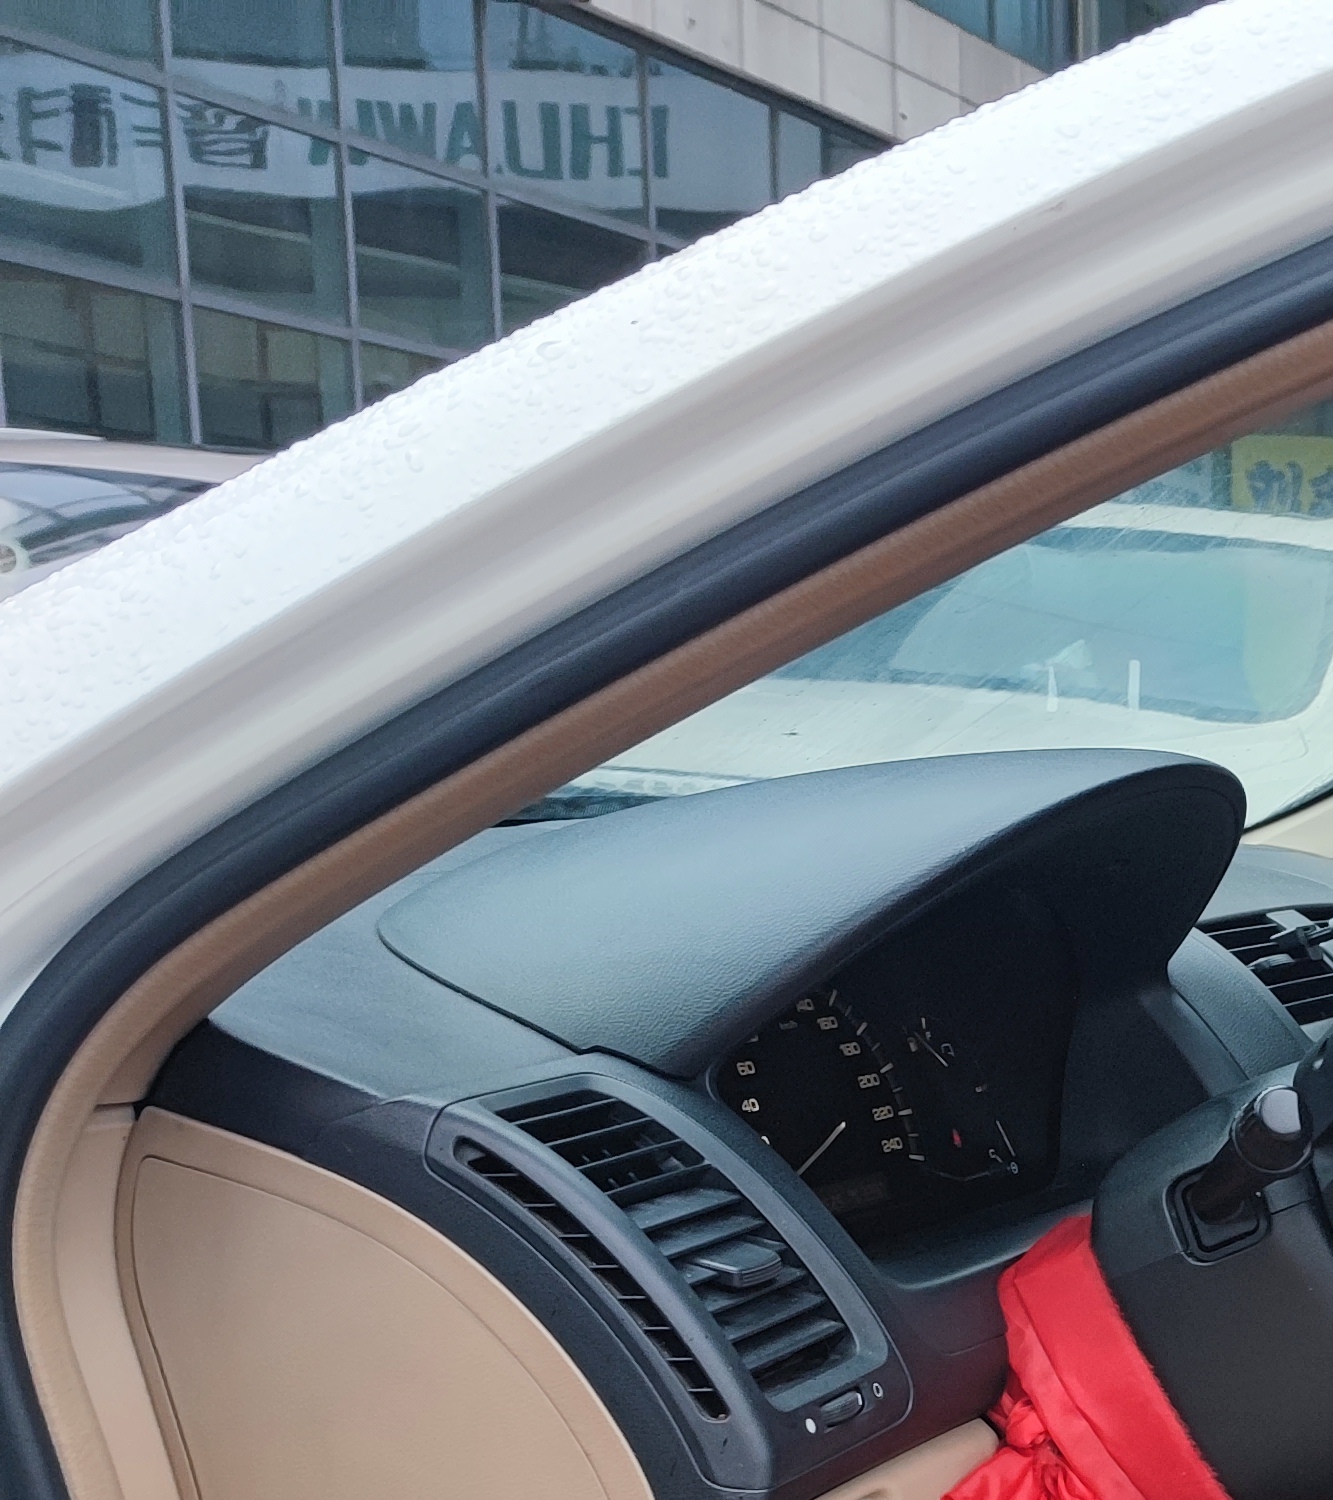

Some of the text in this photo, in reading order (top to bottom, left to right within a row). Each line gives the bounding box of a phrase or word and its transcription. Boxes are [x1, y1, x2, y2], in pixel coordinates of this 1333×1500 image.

[817, 1016, 838, 1030] 160
[839, 1041, 861, 1056] 180
[736, 1061, 756, 1076] 60
[857, 1073, 880, 1089] 200
[741, 1098, 760, 1112] 40
[871, 1105, 894, 1121] 220
[881, 1137, 903, 1153] 240
